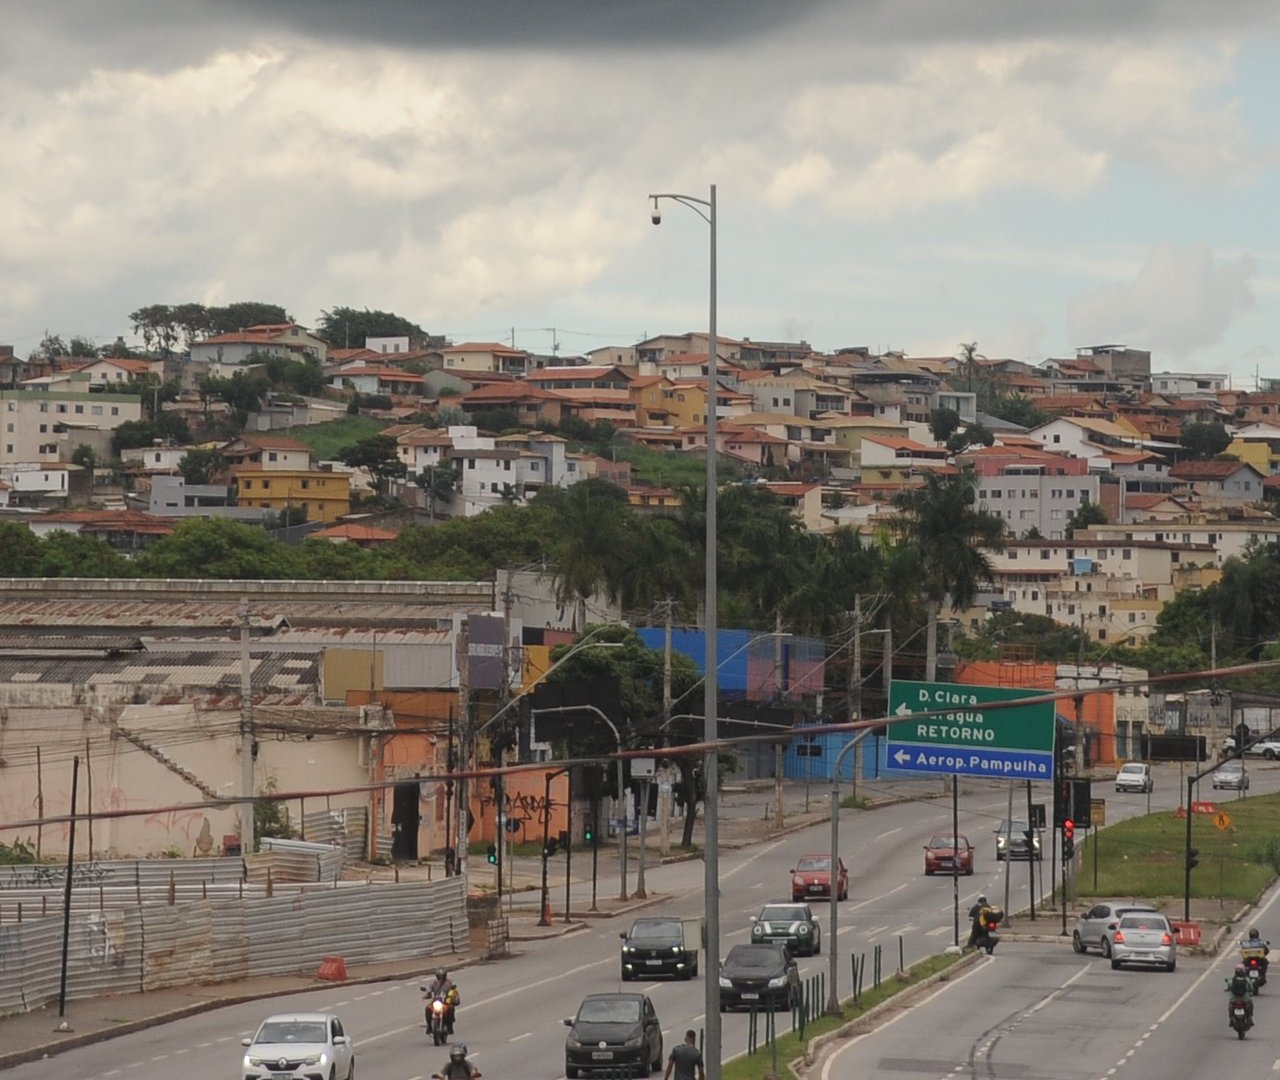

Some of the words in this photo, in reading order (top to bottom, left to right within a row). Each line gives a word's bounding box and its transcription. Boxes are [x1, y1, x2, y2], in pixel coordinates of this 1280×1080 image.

[919, 690, 931, 702] D.
[935, 691, 978, 705] Clara
[917, 724, 995, 741] RETORNO
[916, 752, 967, 769] Aerop.
[970, 756, 1046, 773] Pampulha
